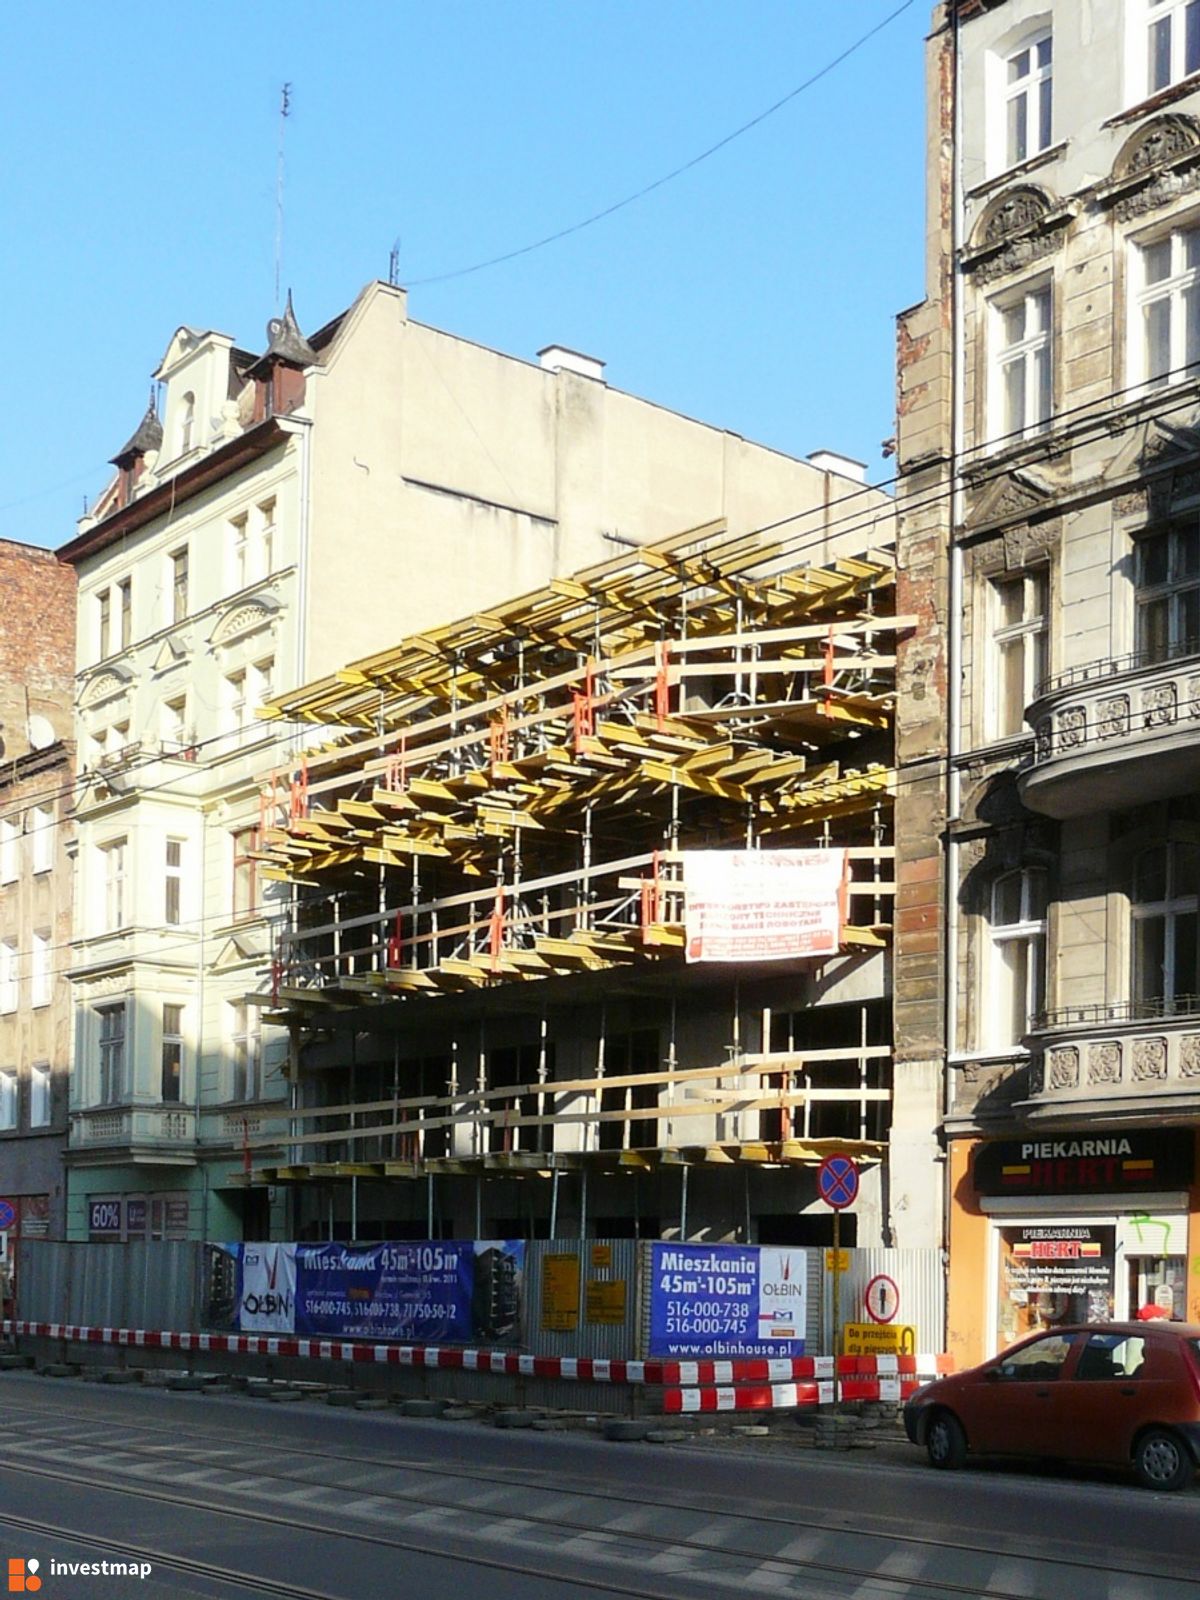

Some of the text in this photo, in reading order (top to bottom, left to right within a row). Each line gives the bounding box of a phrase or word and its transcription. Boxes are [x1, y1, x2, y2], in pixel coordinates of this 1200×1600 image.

[1021, 1138, 1132, 1160] PIEKARNIA
[92, 1204, 118, 1229] 60%
[1022, 1228, 1091, 1239] PIEKARNIA
[1031, 1241, 1081, 1259] HERT
[304, 1249, 376, 1271] Mieszkania
[660, 1252, 756, 1274] Mieszkania
[763, 1283, 802, 1297] OŁBIN
[666, 1301, 749, 1318] 516-000-738
[666, 1318, 747, 1333] 516-000-745
[849, 1328, 860, 1338] Do
[668, 1340, 792, 1357] www.olbinhouse.pl
